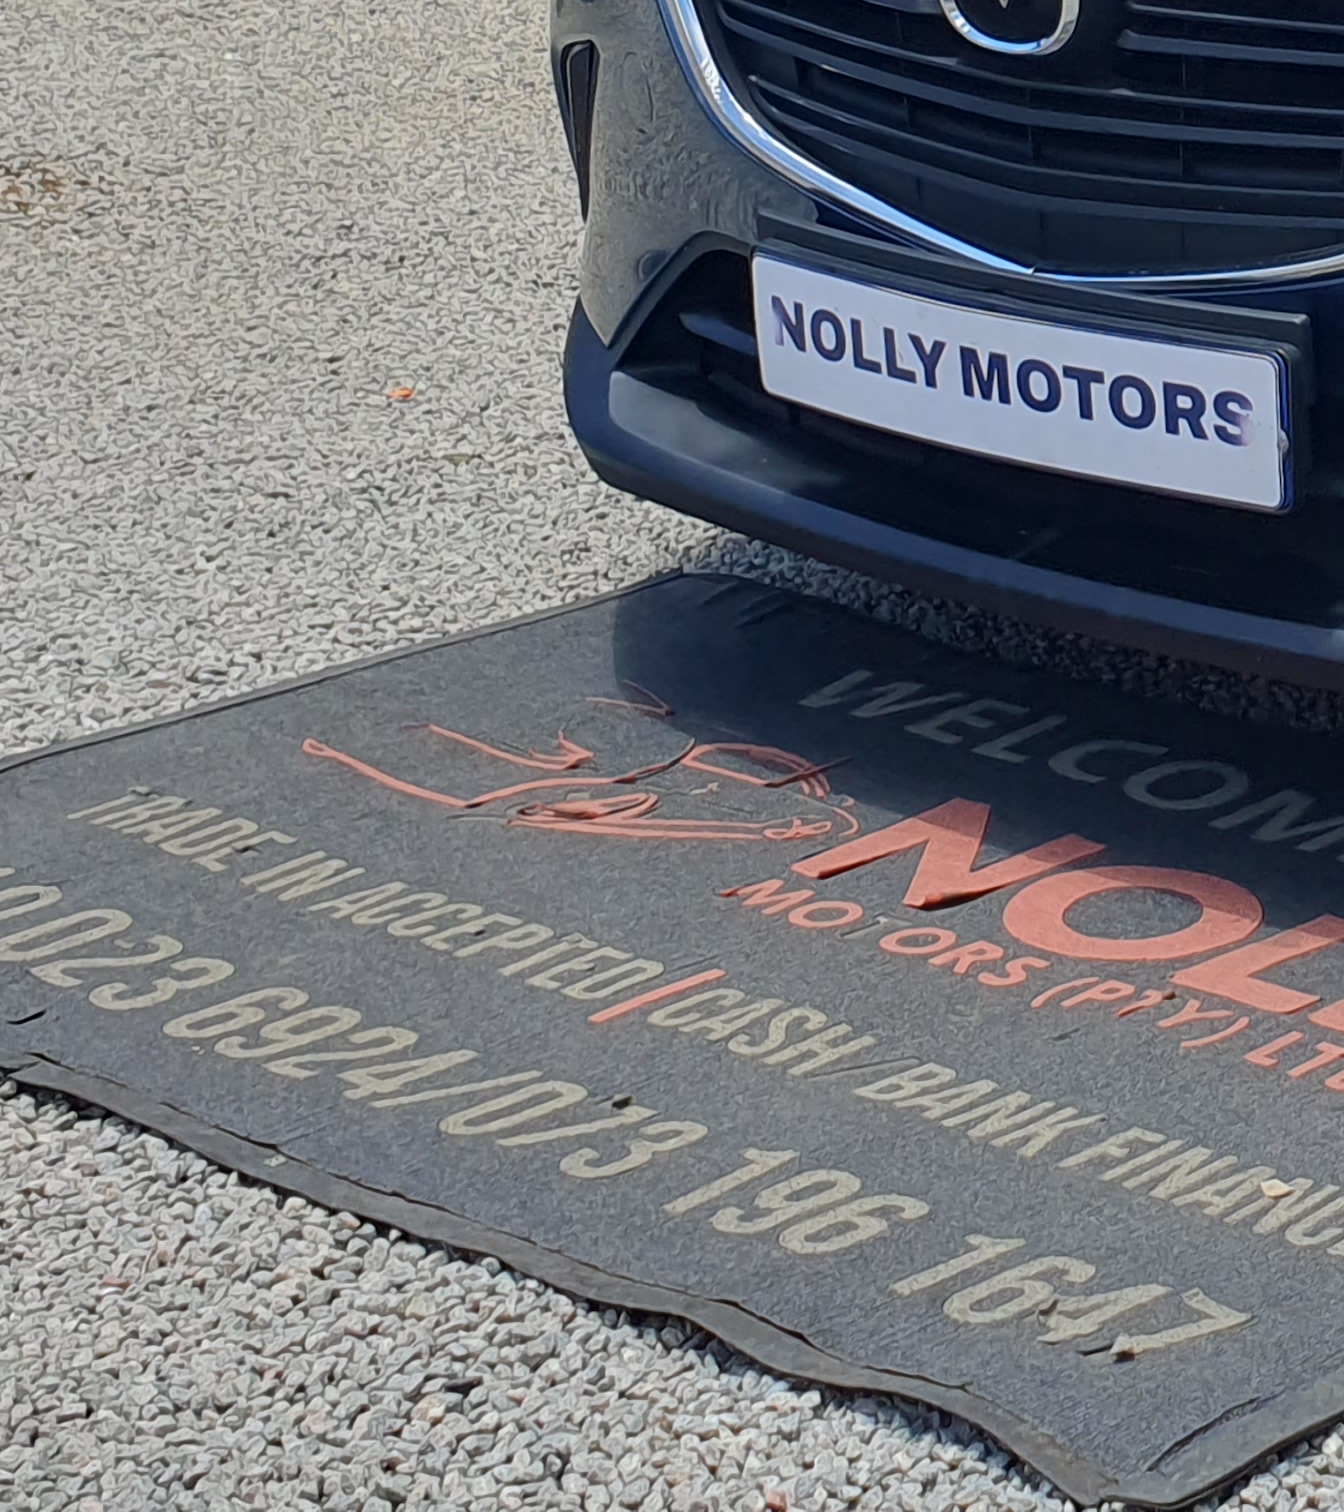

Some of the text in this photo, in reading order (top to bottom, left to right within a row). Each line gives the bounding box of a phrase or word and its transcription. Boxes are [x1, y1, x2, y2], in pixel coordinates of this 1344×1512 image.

[770, 294, 1255, 448] NOLLY MOTORS
[65, 786, 300, 873] TRADE
[240, 849, 367, 903] IN
[662, 1146, 932, 1255] 196
[888, 1232, 1255, 1357] 1647
